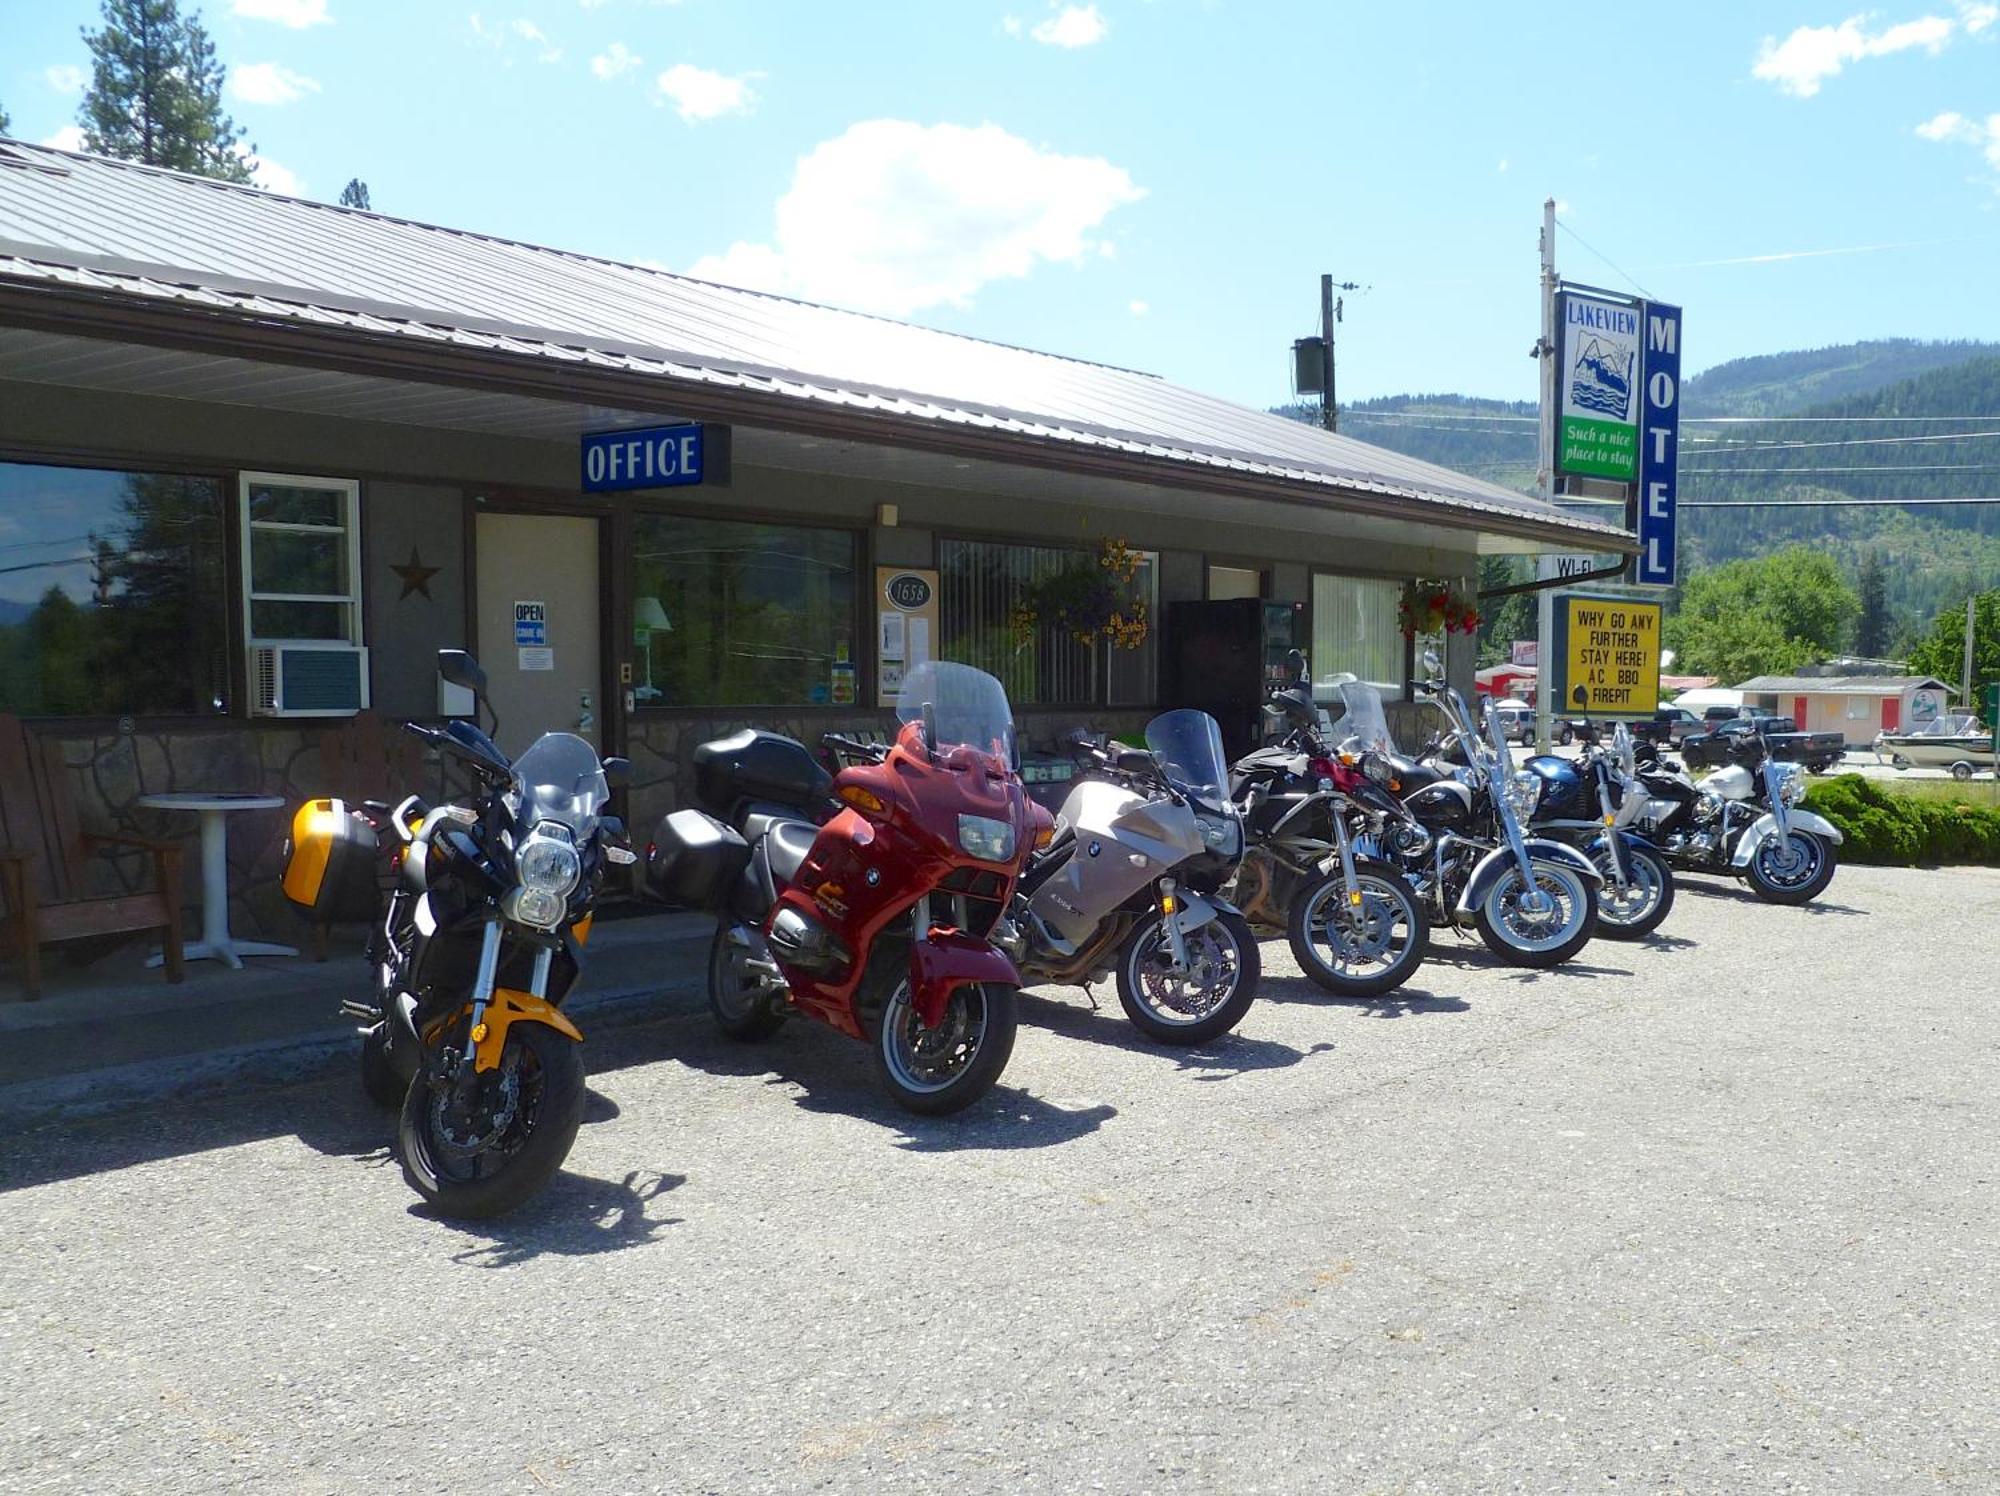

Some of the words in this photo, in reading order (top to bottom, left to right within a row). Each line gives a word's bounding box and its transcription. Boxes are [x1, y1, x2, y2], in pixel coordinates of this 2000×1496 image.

[1568, 302, 1637, 336] LAKEVIEW
[1567, 425, 1596, 443] Such
[1599, 431, 1607, 443] a
[1609, 431, 1631, 447] nice
[1648, 316, 1676, 574] MOTEL
[587, 436, 697, 482] OFFICE
[1563, 444, 1595, 463] place
[1597, 448, 1608, 463] to
[1610, 450, 1633, 472] stay
[896, 582, 926, 602] 1658
[515, 604, 544, 621] OPEN
[1578, 610, 1605, 627] WHY
[1610, 612, 1625, 629] GO
[1630, 614, 1654, 630] ANY
[1590, 631, 1639, 648] FURTHER
[1581, 649, 1609, 665] STAY
[1615, 651, 1647, 667] HERE!
[1618, 669, 1639, 684] BBQ
[1592, 688, 1632, 704] FIREPIT
